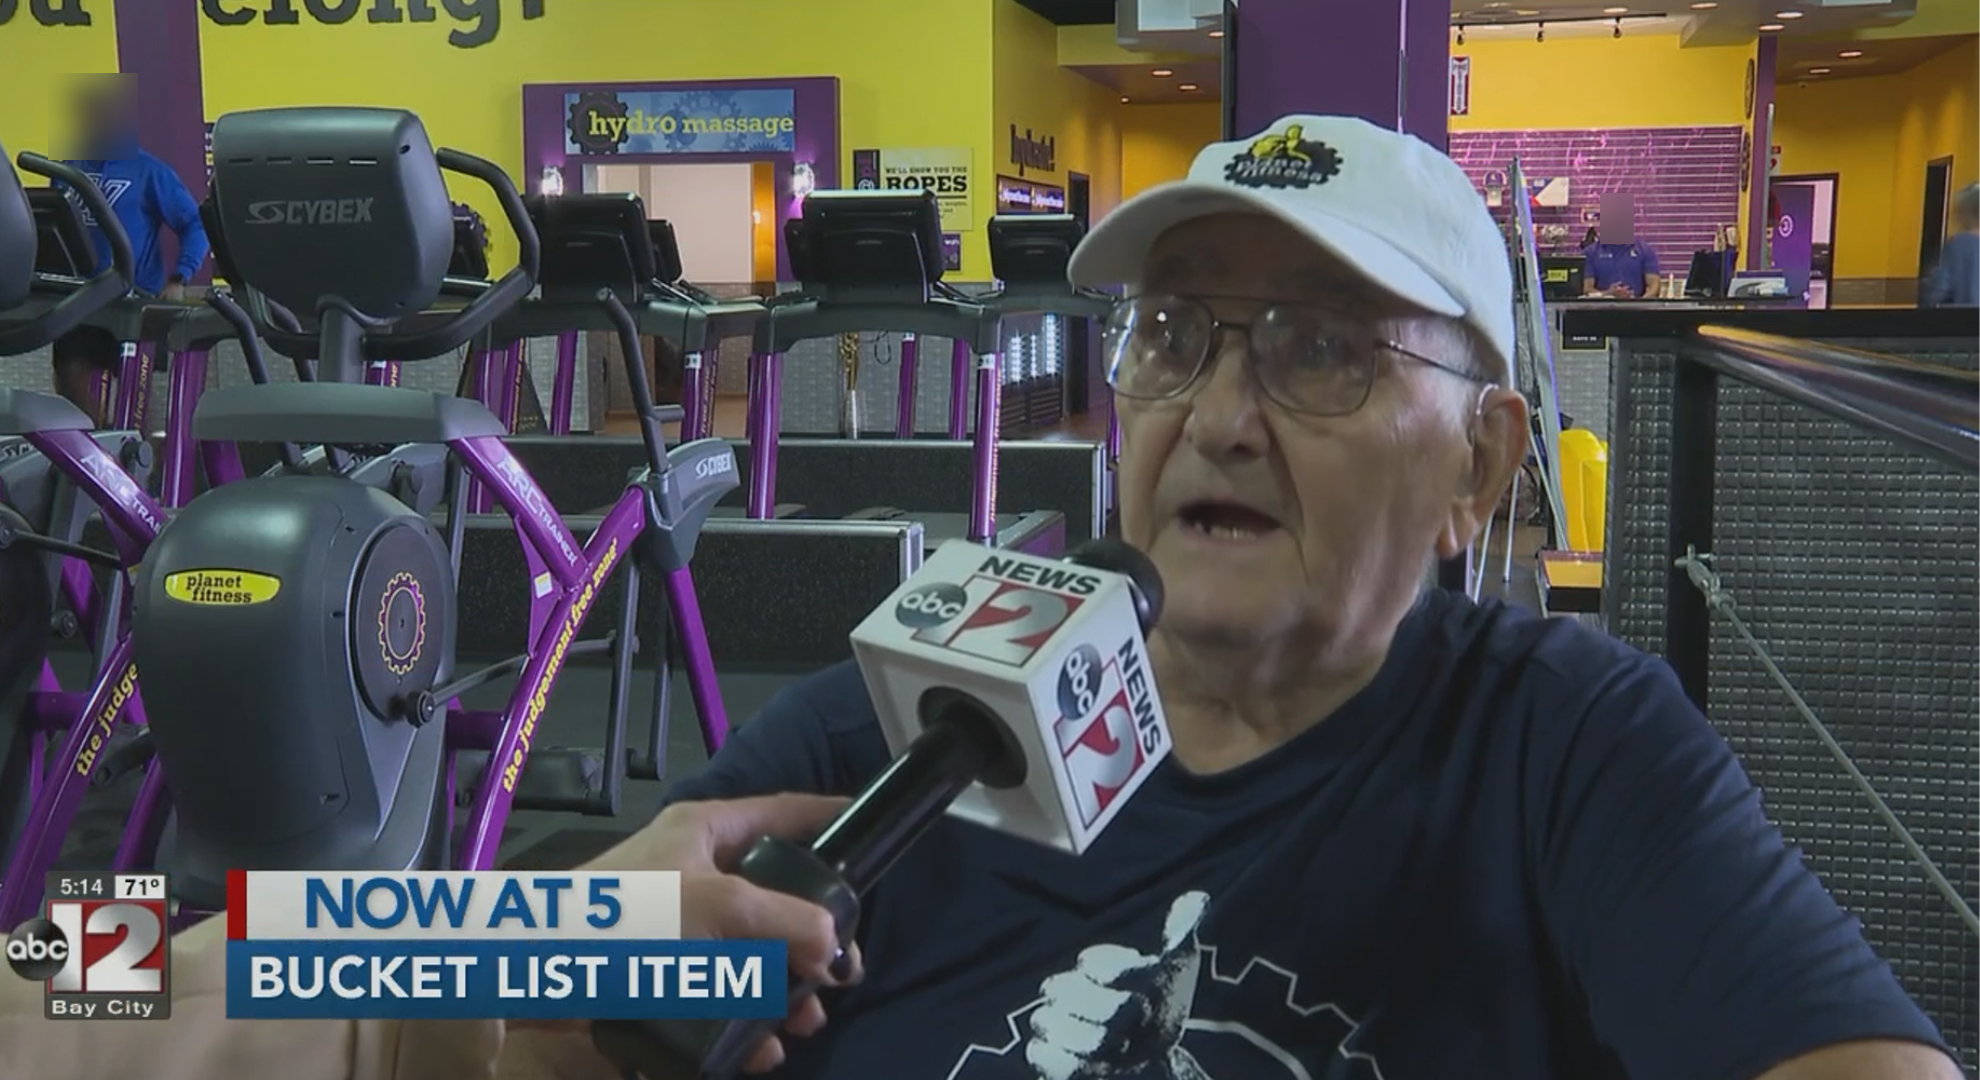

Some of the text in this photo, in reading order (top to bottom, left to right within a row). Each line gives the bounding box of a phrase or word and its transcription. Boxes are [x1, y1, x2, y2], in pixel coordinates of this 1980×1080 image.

[588, 109, 794, 142] hydro massage
[886, 175, 968, 193] ROPES
[934, 166, 950, 174] YOU
[952, 166, 968, 174] THE
[286, 197, 374, 225] CYBEX
[707, 452, 732, 477] CYBEX
[186, 573, 242, 590] planet
[979, 555, 1102, 596] NEWS
[191, 587, 252, 603] fitness
[901, 575, 1068, 667] abc 12
[503, 749, 522, 793] the
[519, 619, 573, 753] judgement
[571, 584, 593, 627] free
[1117, 636, 1162, 756] NEWS
[76, 663, 138, 776] the judge
[1055, 650, 1138, 829] abc 12
